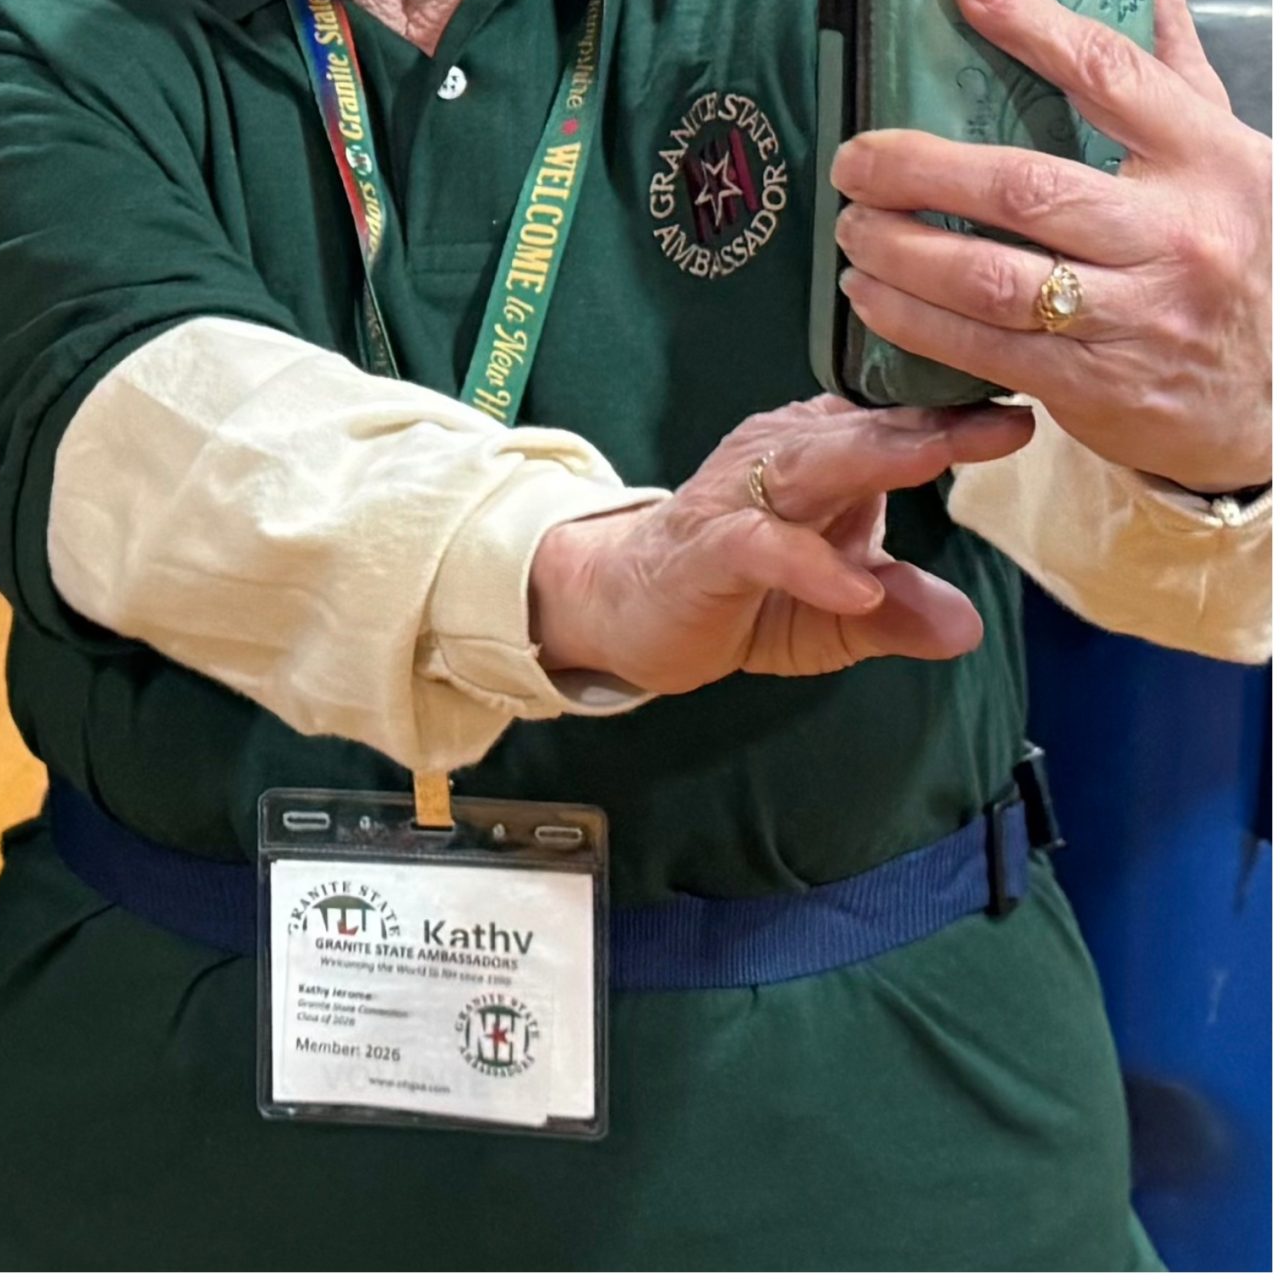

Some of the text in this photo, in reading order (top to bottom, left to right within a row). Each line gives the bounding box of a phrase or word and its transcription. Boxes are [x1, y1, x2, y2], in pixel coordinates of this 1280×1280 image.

[326, 53, 364, 140] Granite
[649, 91, 780, 219] GRANITE STATE
[505, 142, 582, 293] WELCOME
[653, 159, 788, 280] AMBASSADOR
[503, 296, 535, 323] to
[486, 323, 529, 387] New
[287, 880, 401, 937] GRANITE STATE
[315, 937, 521, 971] GRANITE STATE AMBASSADORS
[298, 984, 330, 999] Kathy
[296, 1036, 402, 1062] Member: 2026
